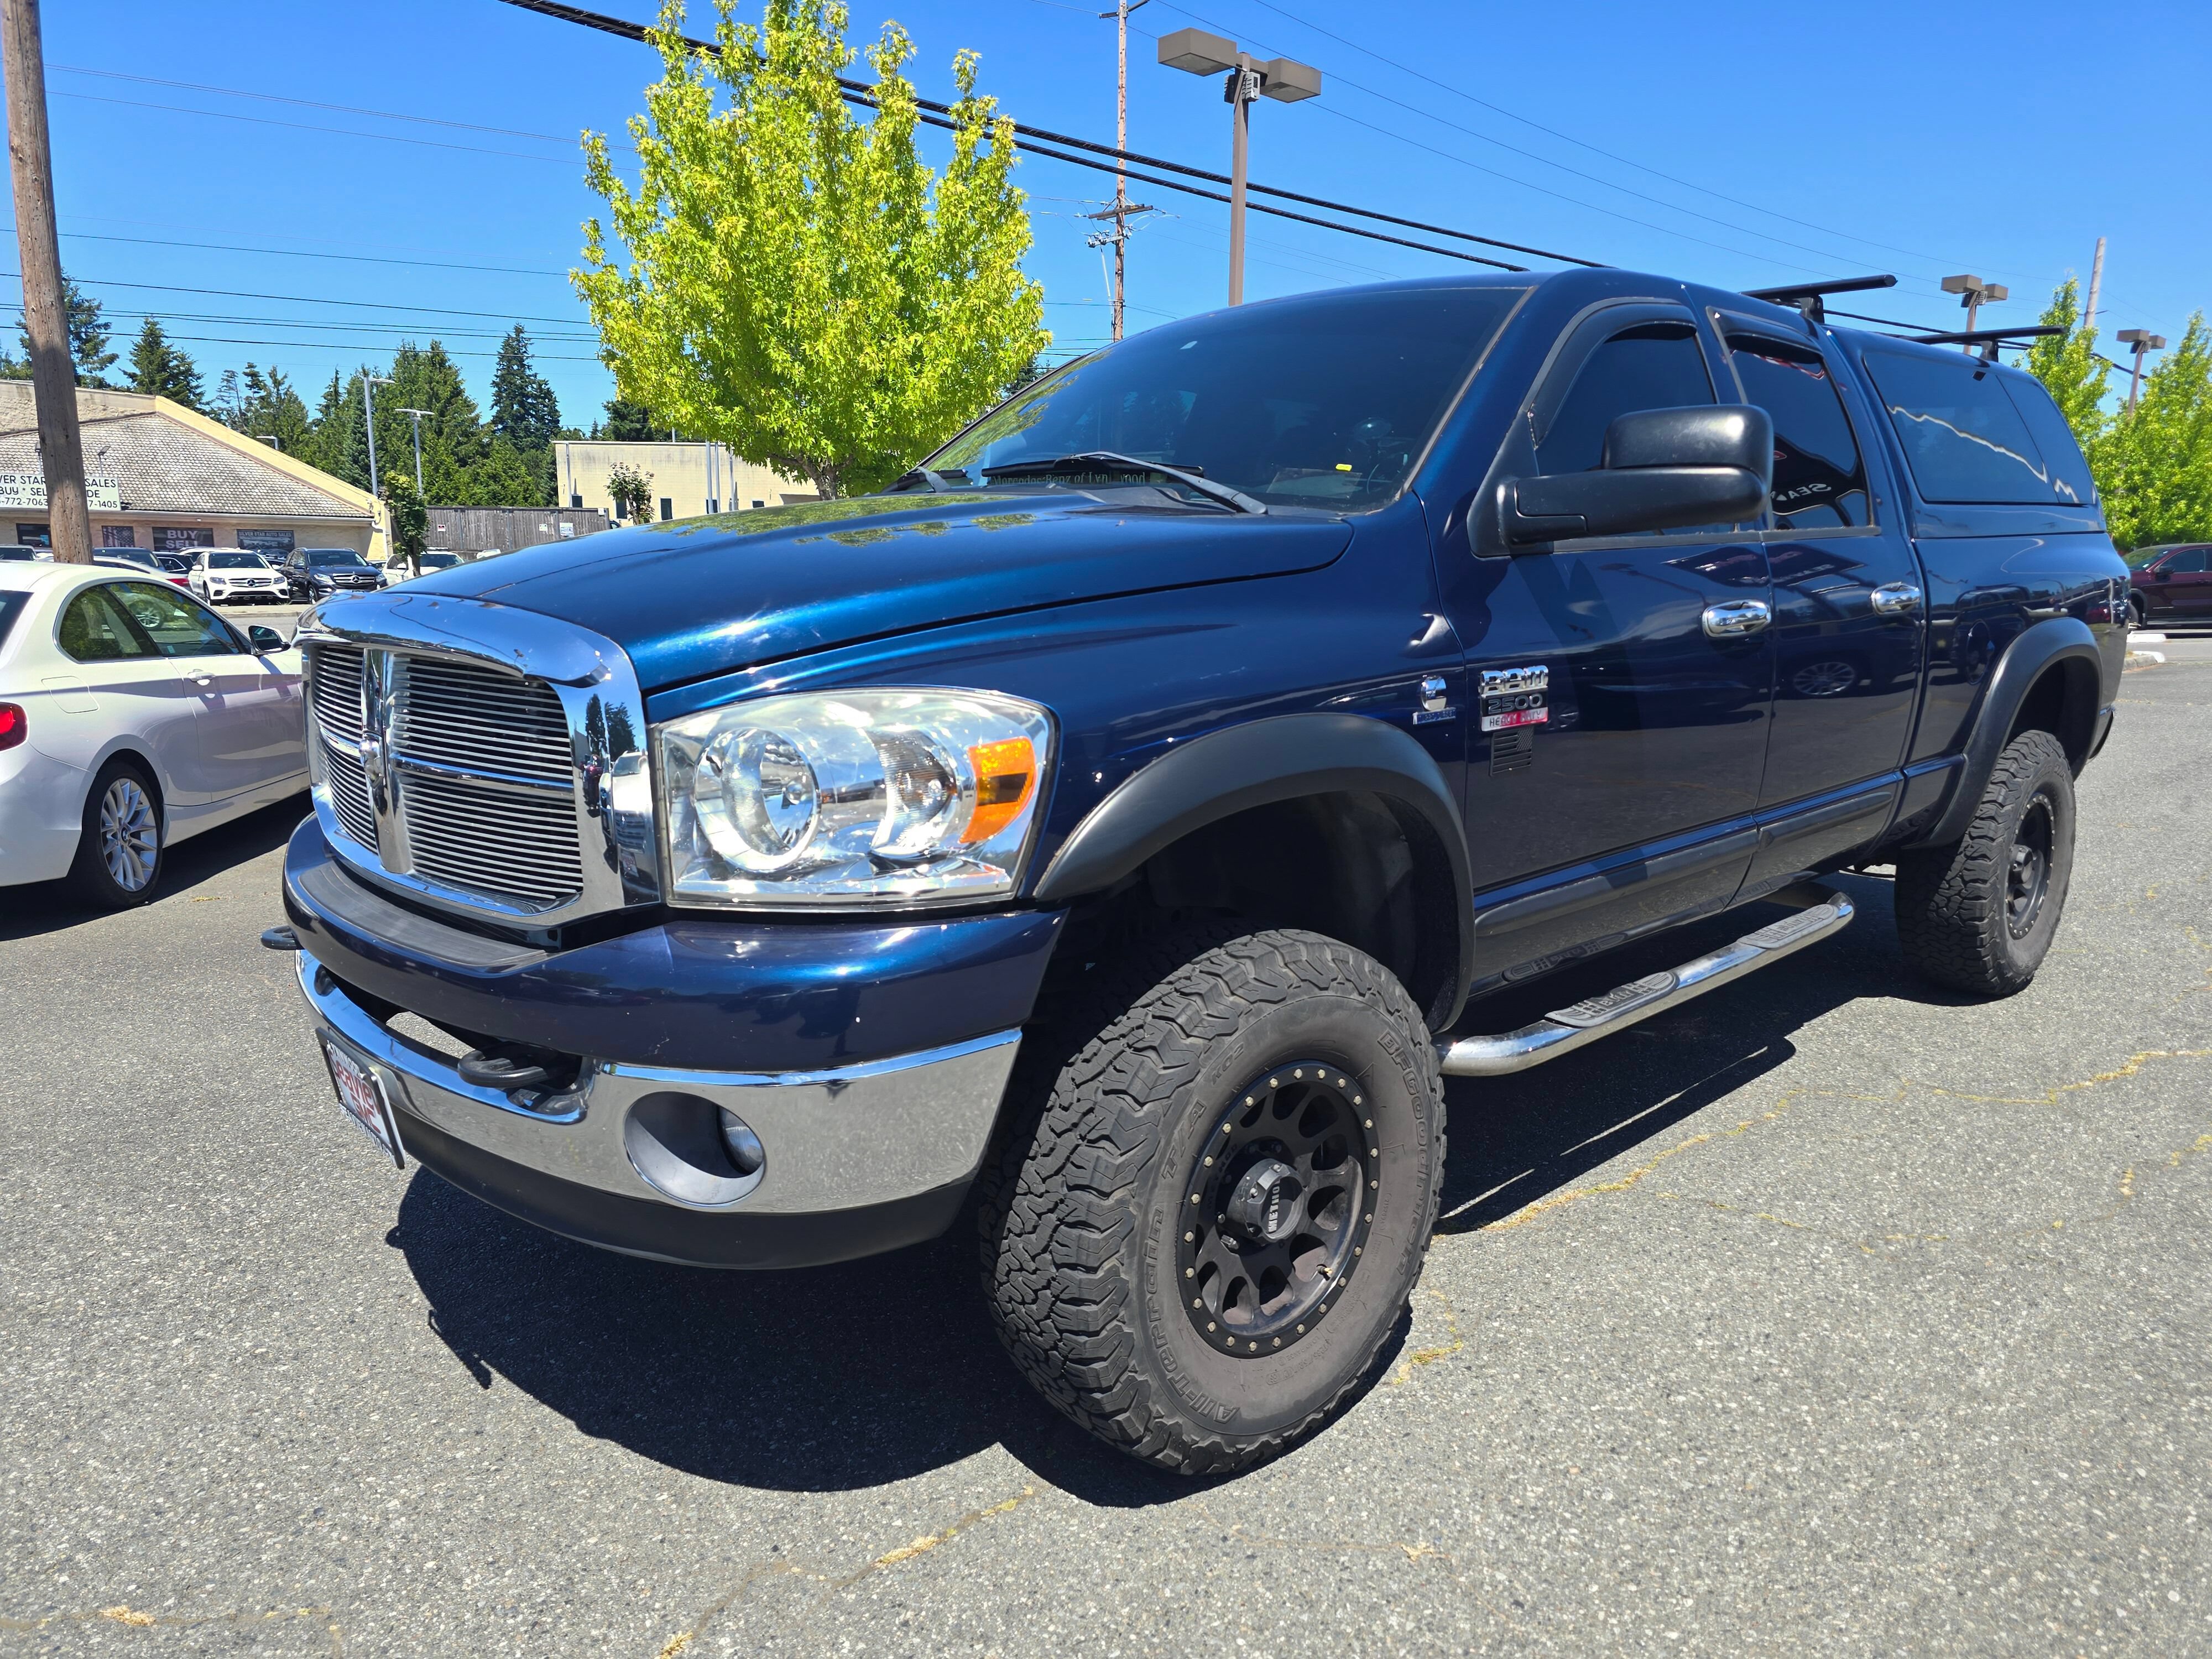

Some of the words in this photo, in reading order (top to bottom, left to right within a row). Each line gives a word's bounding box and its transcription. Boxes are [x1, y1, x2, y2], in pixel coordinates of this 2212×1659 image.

[30, 487, 47, 496] SEL
[85, 478, 116, 488] SALES
[166, 530, 198, 539] BUY
[1488, 693, 1543, 714] 2500
[1489, 713, 1517, 727] HEAVY
[1520, 711, 1542, 723] DUTY
[1211, 1042, 1244, 1086] KO2
[1161, 1097, 1207, 1180] T/A
[1143, 1205, 1240, 1424] All-Terrain
